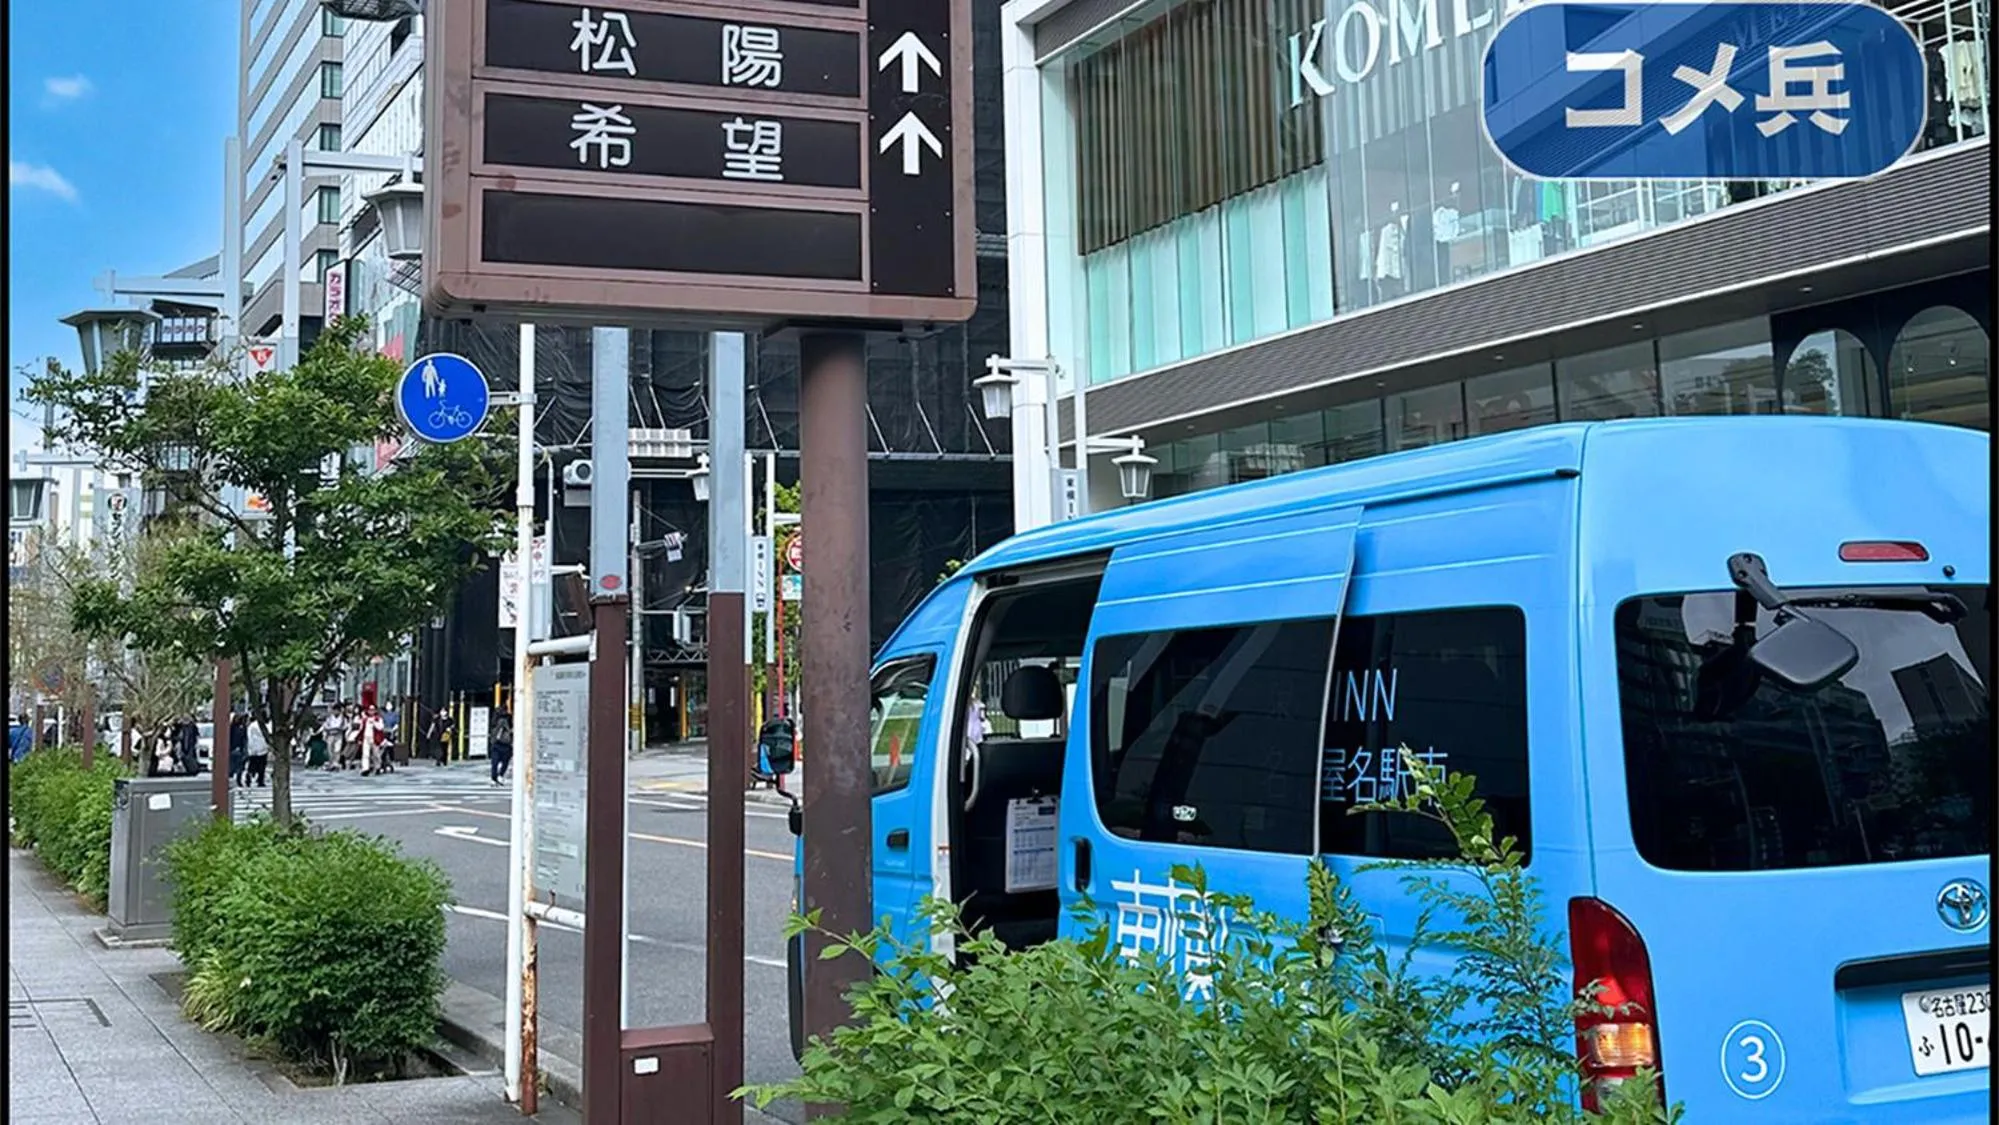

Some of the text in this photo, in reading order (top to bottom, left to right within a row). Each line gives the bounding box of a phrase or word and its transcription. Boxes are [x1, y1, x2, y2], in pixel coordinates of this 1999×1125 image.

[570, 8, 784, 87] 松陽
[570, 103, 784, 181] 希望
[329, 272, 342, 320] カラオ
[1918, 1035, 1935, 1057] ふ
